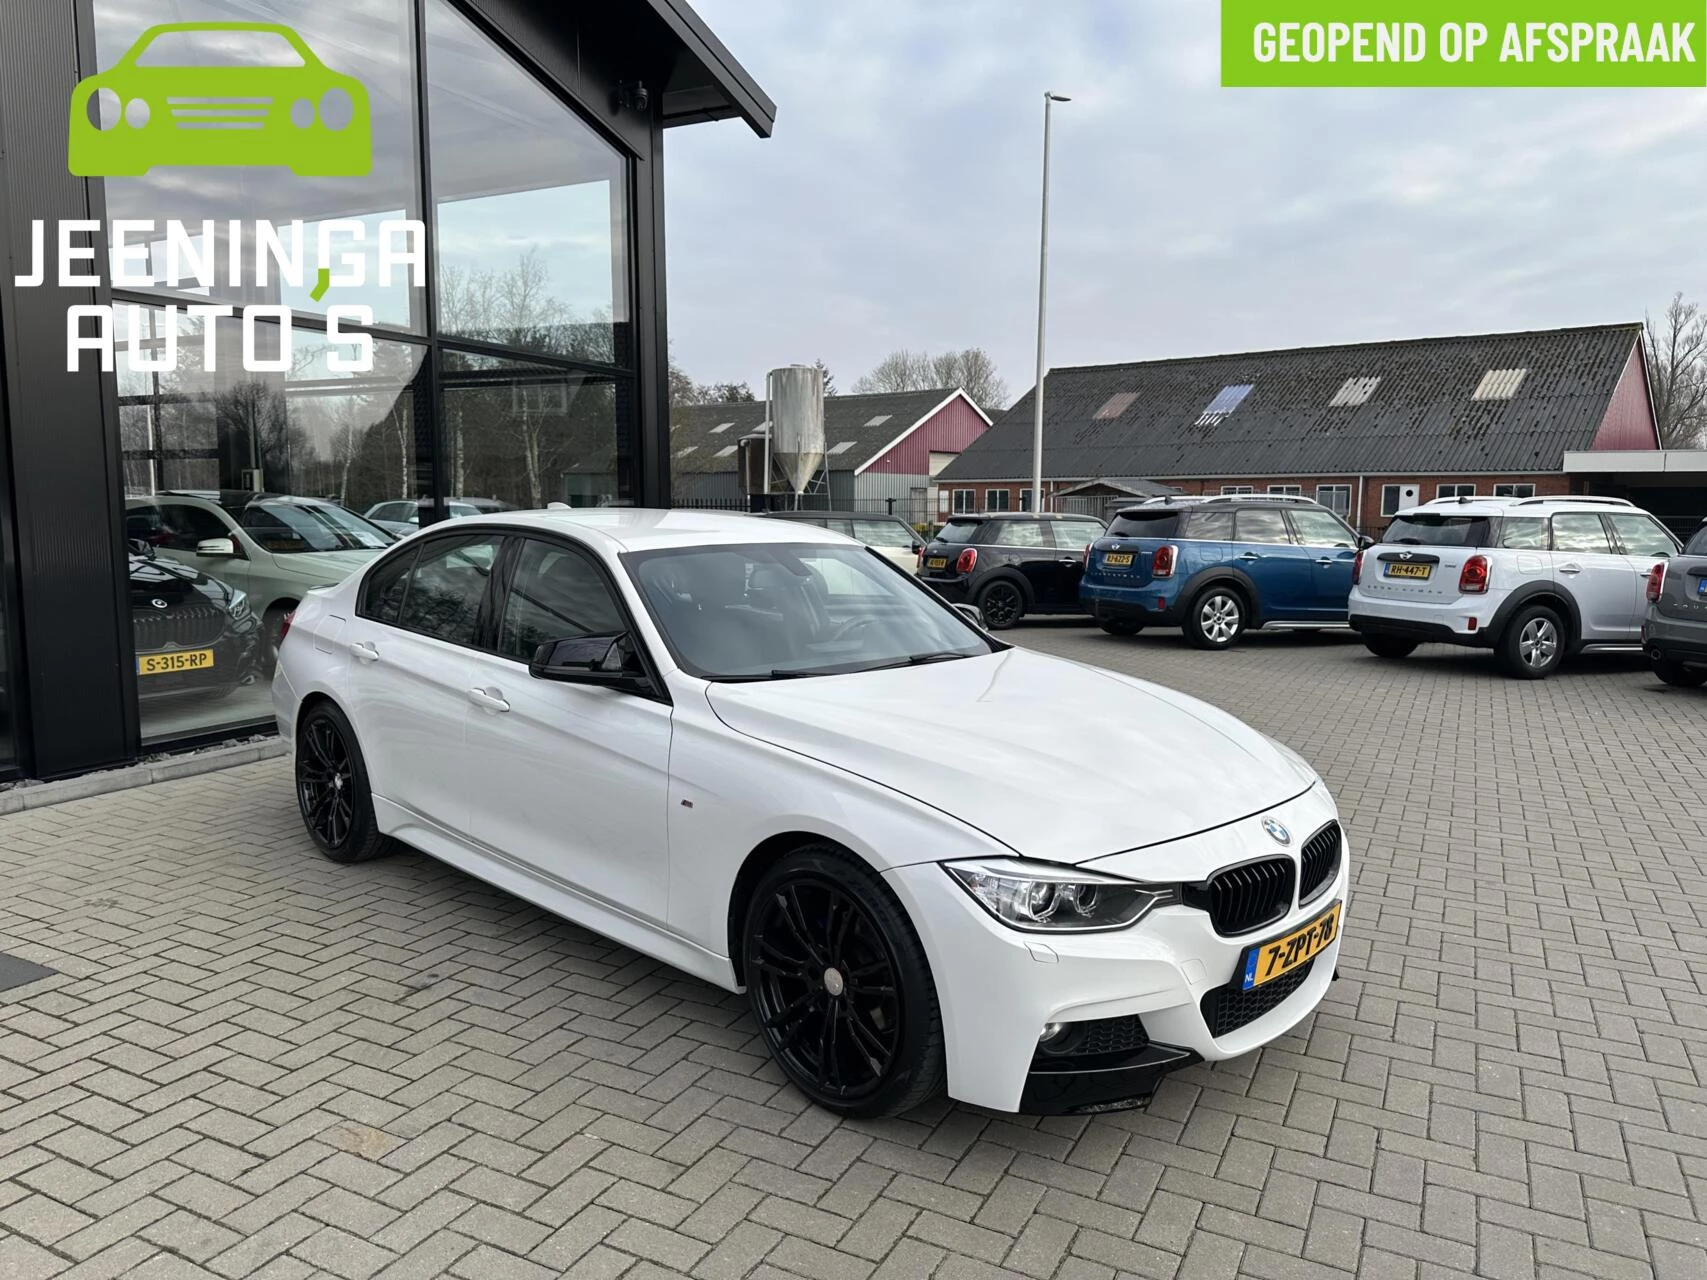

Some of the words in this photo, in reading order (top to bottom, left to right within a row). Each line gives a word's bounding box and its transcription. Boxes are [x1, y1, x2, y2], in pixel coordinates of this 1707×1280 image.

[1390, 565, 1428, 576] RH-447-T
[146, 653, 207, 671] S-315-RP
[1265, 912, 1335, 976] 7-ZPT-78
[1244, 973, 1254, 983] NL
